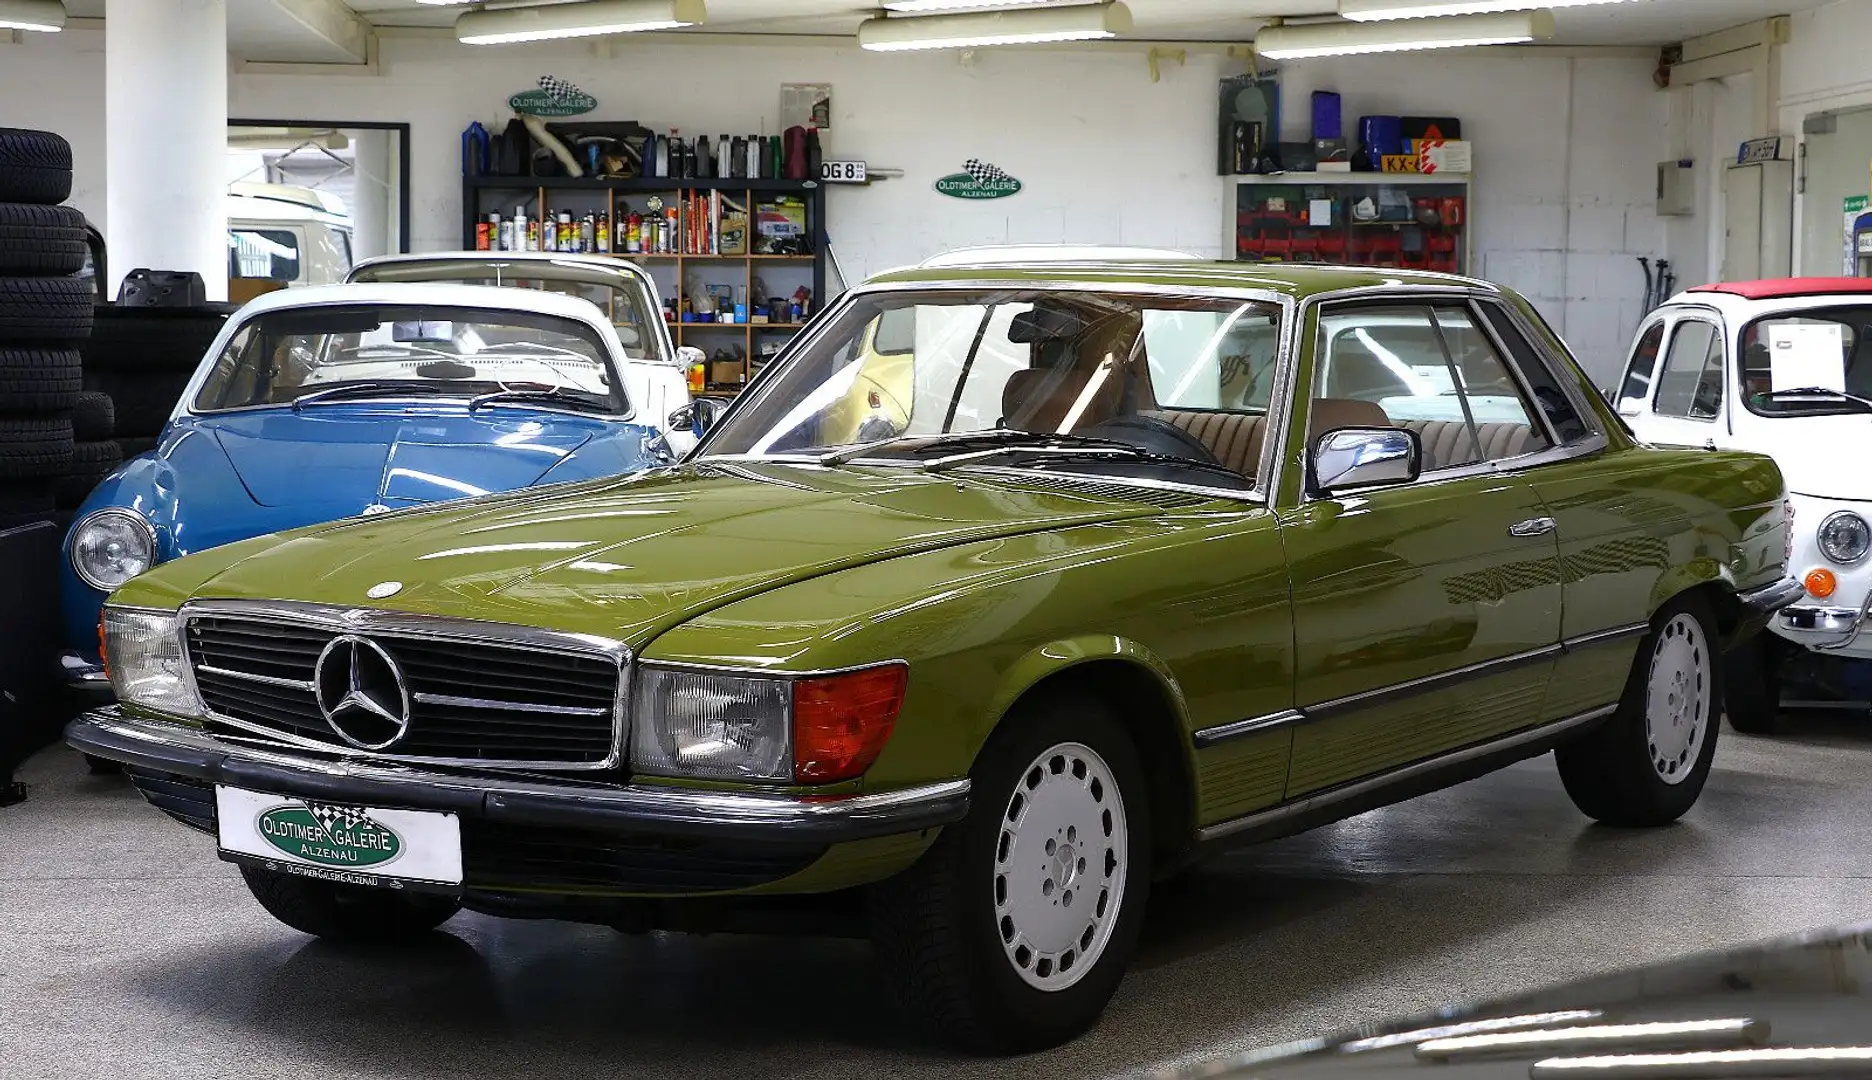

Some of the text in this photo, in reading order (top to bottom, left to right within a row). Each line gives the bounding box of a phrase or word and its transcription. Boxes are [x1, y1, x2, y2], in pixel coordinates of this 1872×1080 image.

[560, 98, 594, 108] GALERIE
[845, 163, 855, 179] 8
[984, 180, 1017, 190] GALERIE
[335, 829, 392, 851] GALERIE
[300, 843, 357, 862] ALZENAU
